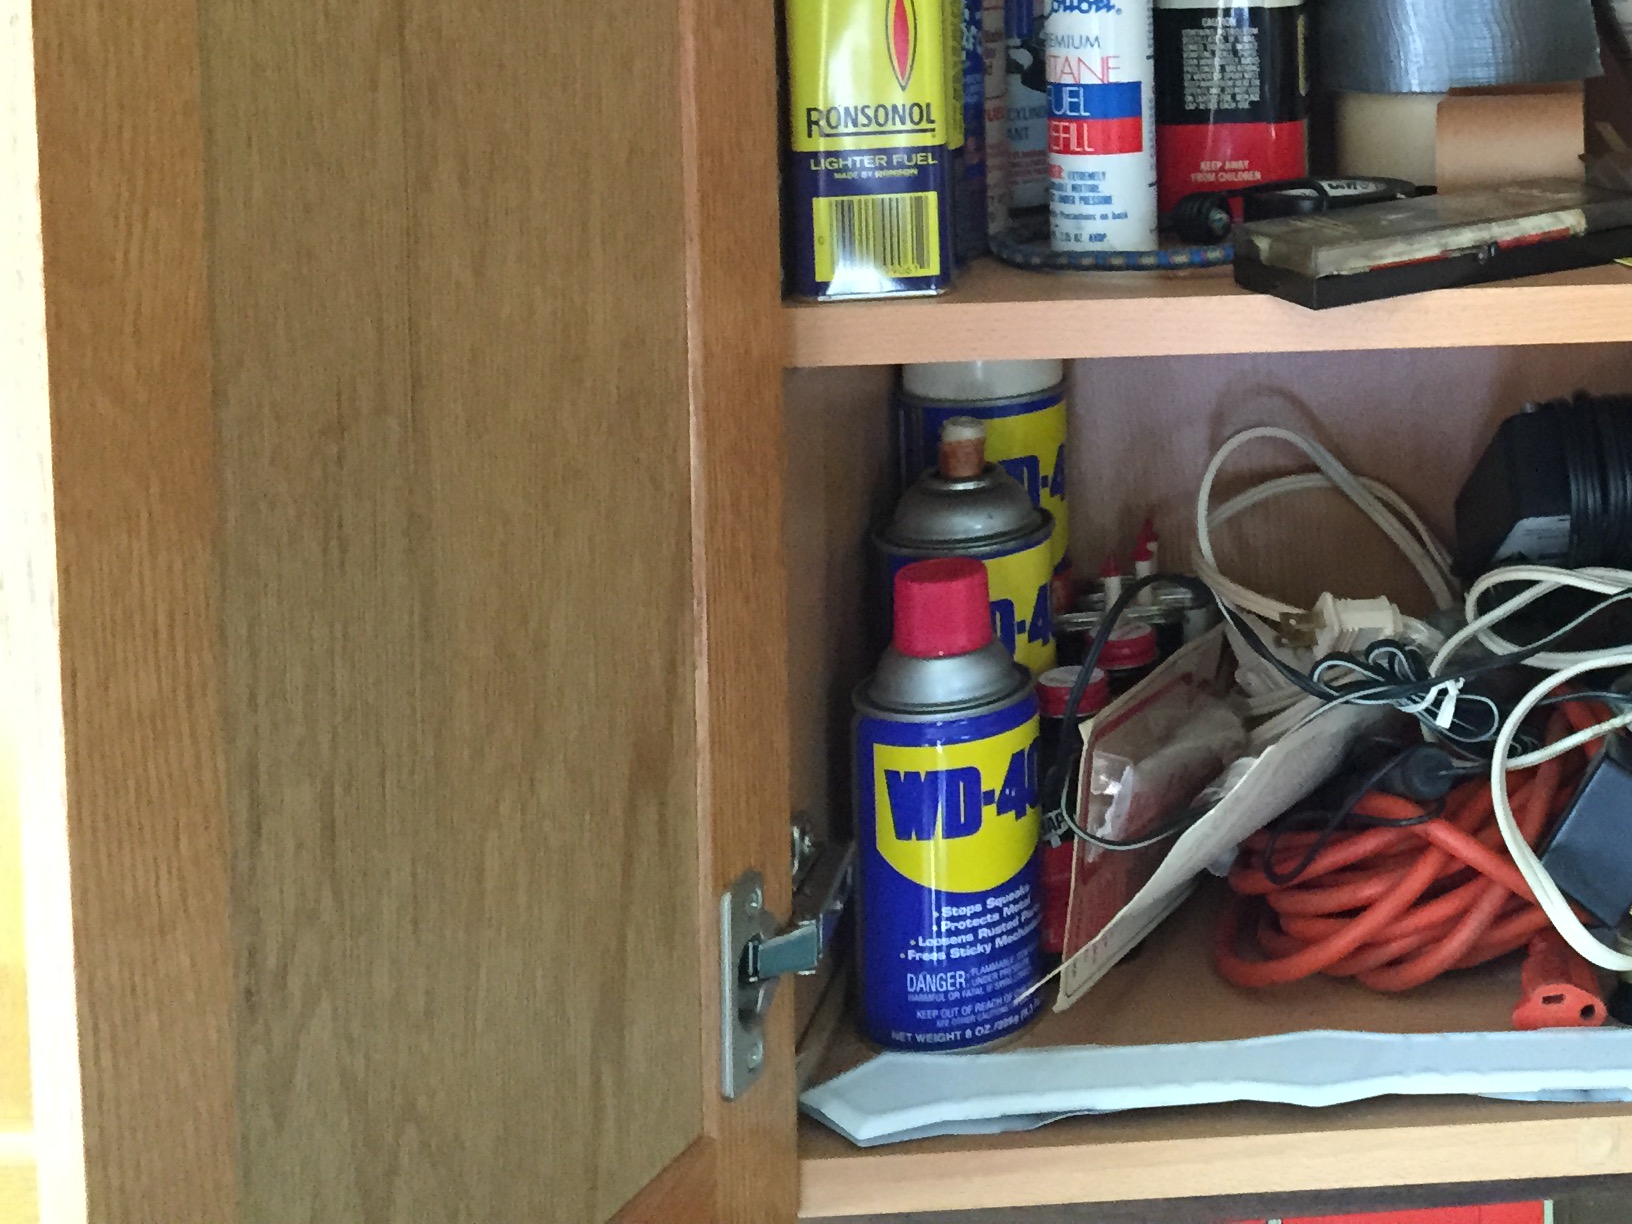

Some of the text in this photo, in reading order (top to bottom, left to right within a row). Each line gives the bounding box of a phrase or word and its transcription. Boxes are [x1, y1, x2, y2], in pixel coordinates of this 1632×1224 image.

[806, 102, 936, 138] RONSONOL
[810, 152, 938, 171] LIGHTER FUEL
[1218, 171, 1262, 181] CHILDREN
[884, 735, 1041, 841] WD-40
[941, 883, 1030, 918] Stops Squeaks
[940, 894, 1031, 932] Protects Metal
[918, 932, 974, 947] Loosens
[978, 916, 1019, 940] Rusted
[907, 949, 946, 961] Frees
[950, 942, 992, 959] Sticky
[906, 971, 966, 992] DANGER
[916, 1009, 939, 1020] KEEP
[940, 1007, 960, 1019] OUT
[961, 1004, 973, 1015] OF
[891, 1030, 913, 1042] NET
[915, 1031, 962, 1043] WEIGHT
